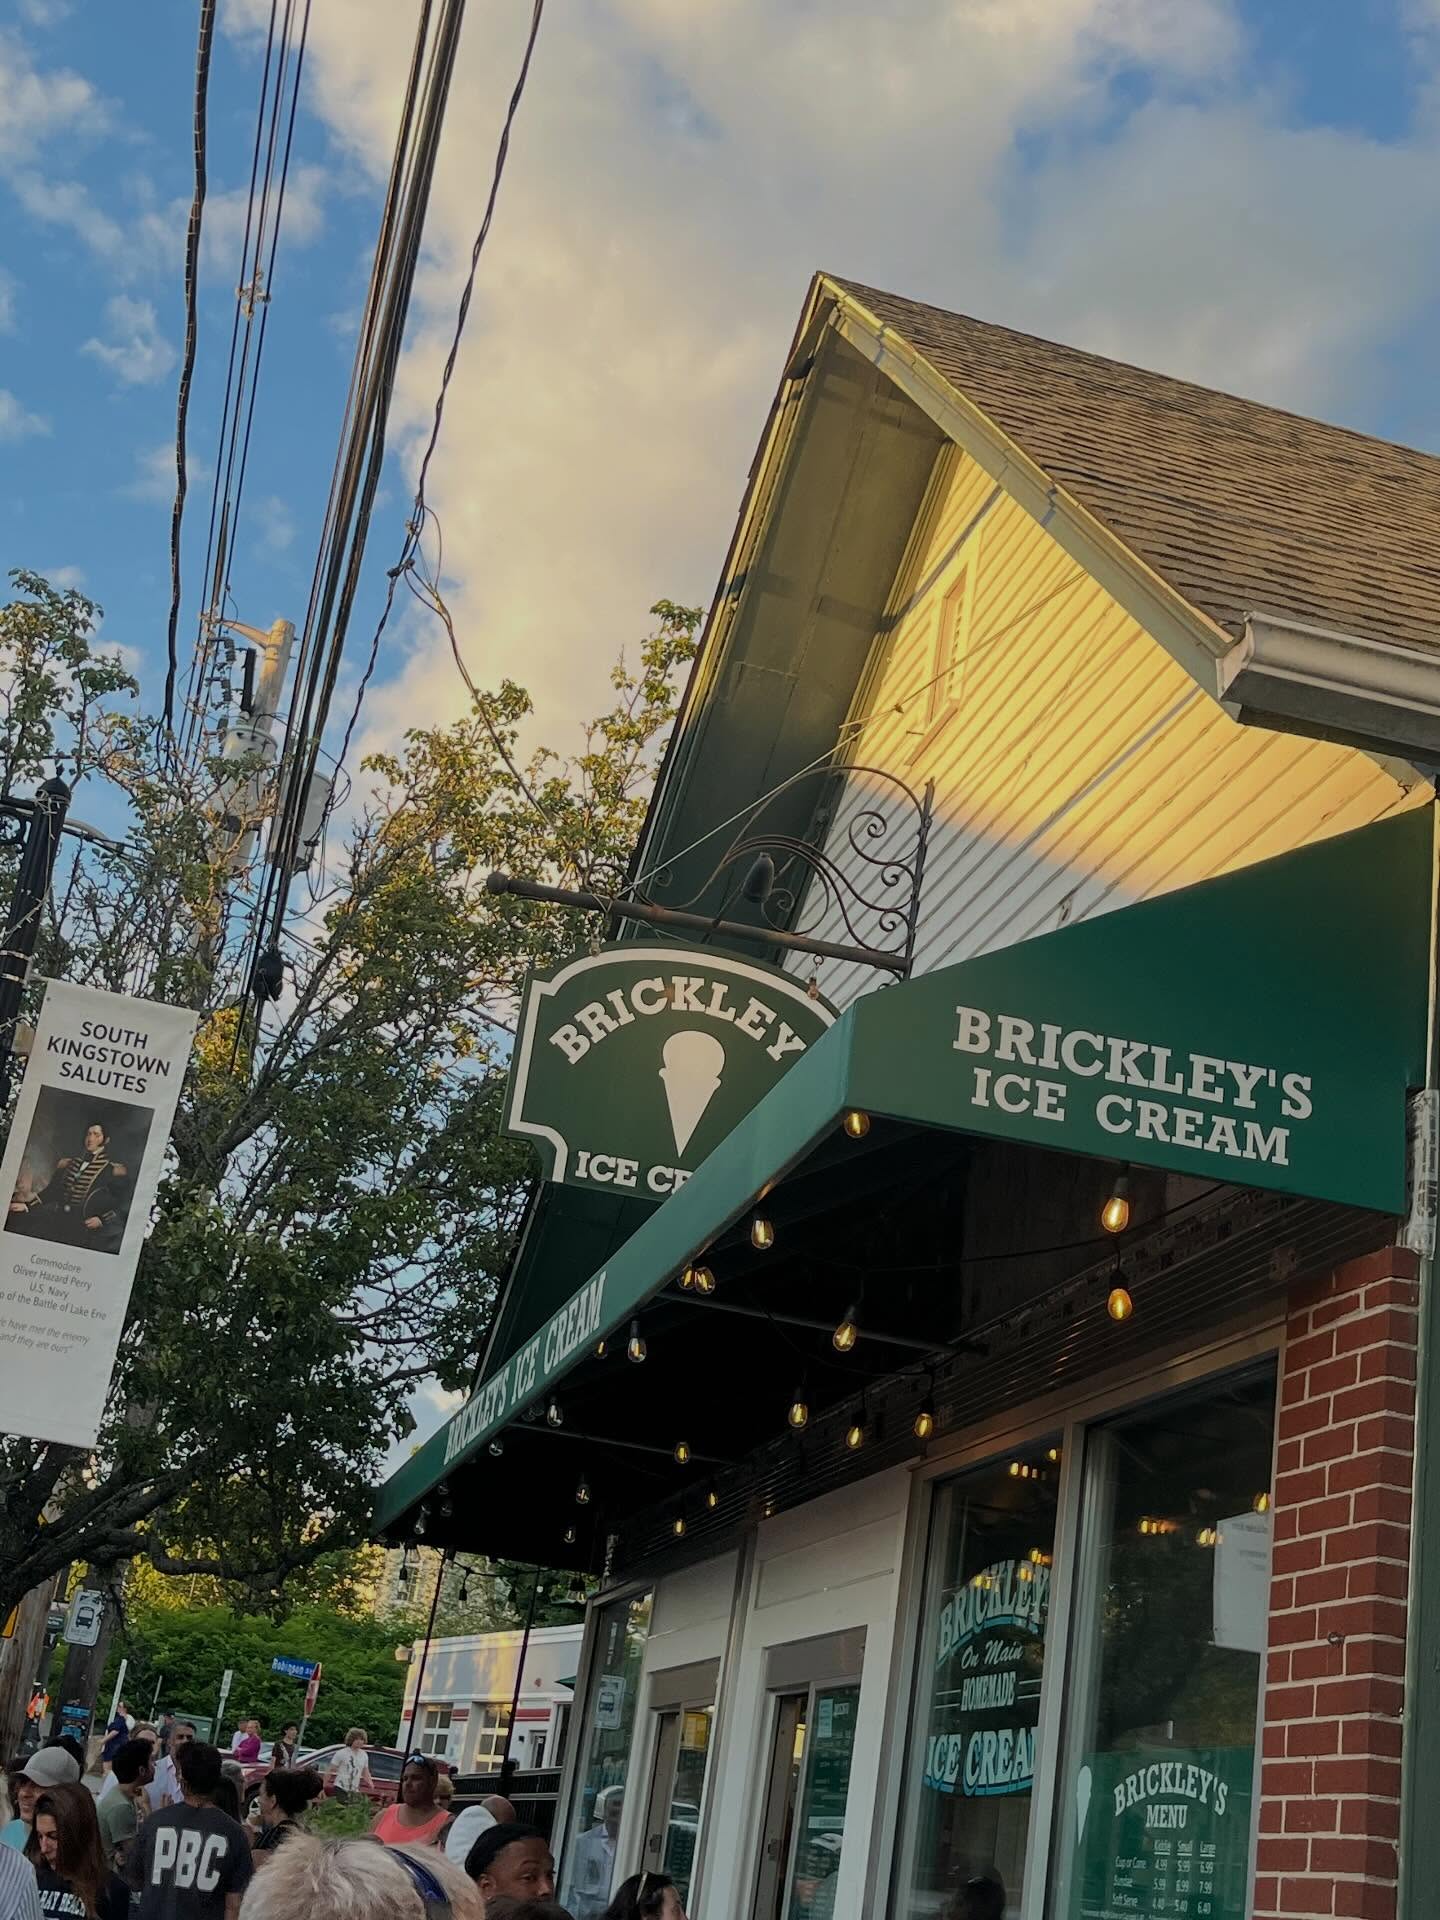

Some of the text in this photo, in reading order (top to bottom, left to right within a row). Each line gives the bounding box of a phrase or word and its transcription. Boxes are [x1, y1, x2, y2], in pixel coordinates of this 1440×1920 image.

[80, 1021, 149, 1049] SOUTH
[549, 976, 807, 1065] BRICKLEY
[47, 1035, 171, 1076] KINGSTOWN
[952, 1005, 1313, 1120] BRICKLEY'S
[59, 1061, 147, 1094] SALUTES
[971, 1067, 1290, 1166] ICE CREAM
[575, 1150, 639, 1187] ICE
[13, 1264, 92, 1291] Oliver Hazard Perry
[30, 1254, 82, 1274] Commodore
[7, 1291, 16, 1301] of
[18, 1293, 31, 1305] the
[33, 1296, 58, 1310] Battle
[60, 1302, 69, 1312] of
[70, 1304, 89, 1317] Lake
[47, 1286, 70, 1300] Navy
[511, 1336, 541, 1405] ICE
[543, 1271, 607, 1375] CREAM
[961, 1640, 1023, 1669] On Main
[960, 1671, 1017, 1712] HOMEMADE
[927, 1733, 962, 1785] ICE
[1113, 1762, 1229, 1816] BRICKLEY'S
[1145, 1804, 1188, 1829] MENU
[151, 1827, 228, 1892] PBC
[39, 1890, 60, 1911] RAY
